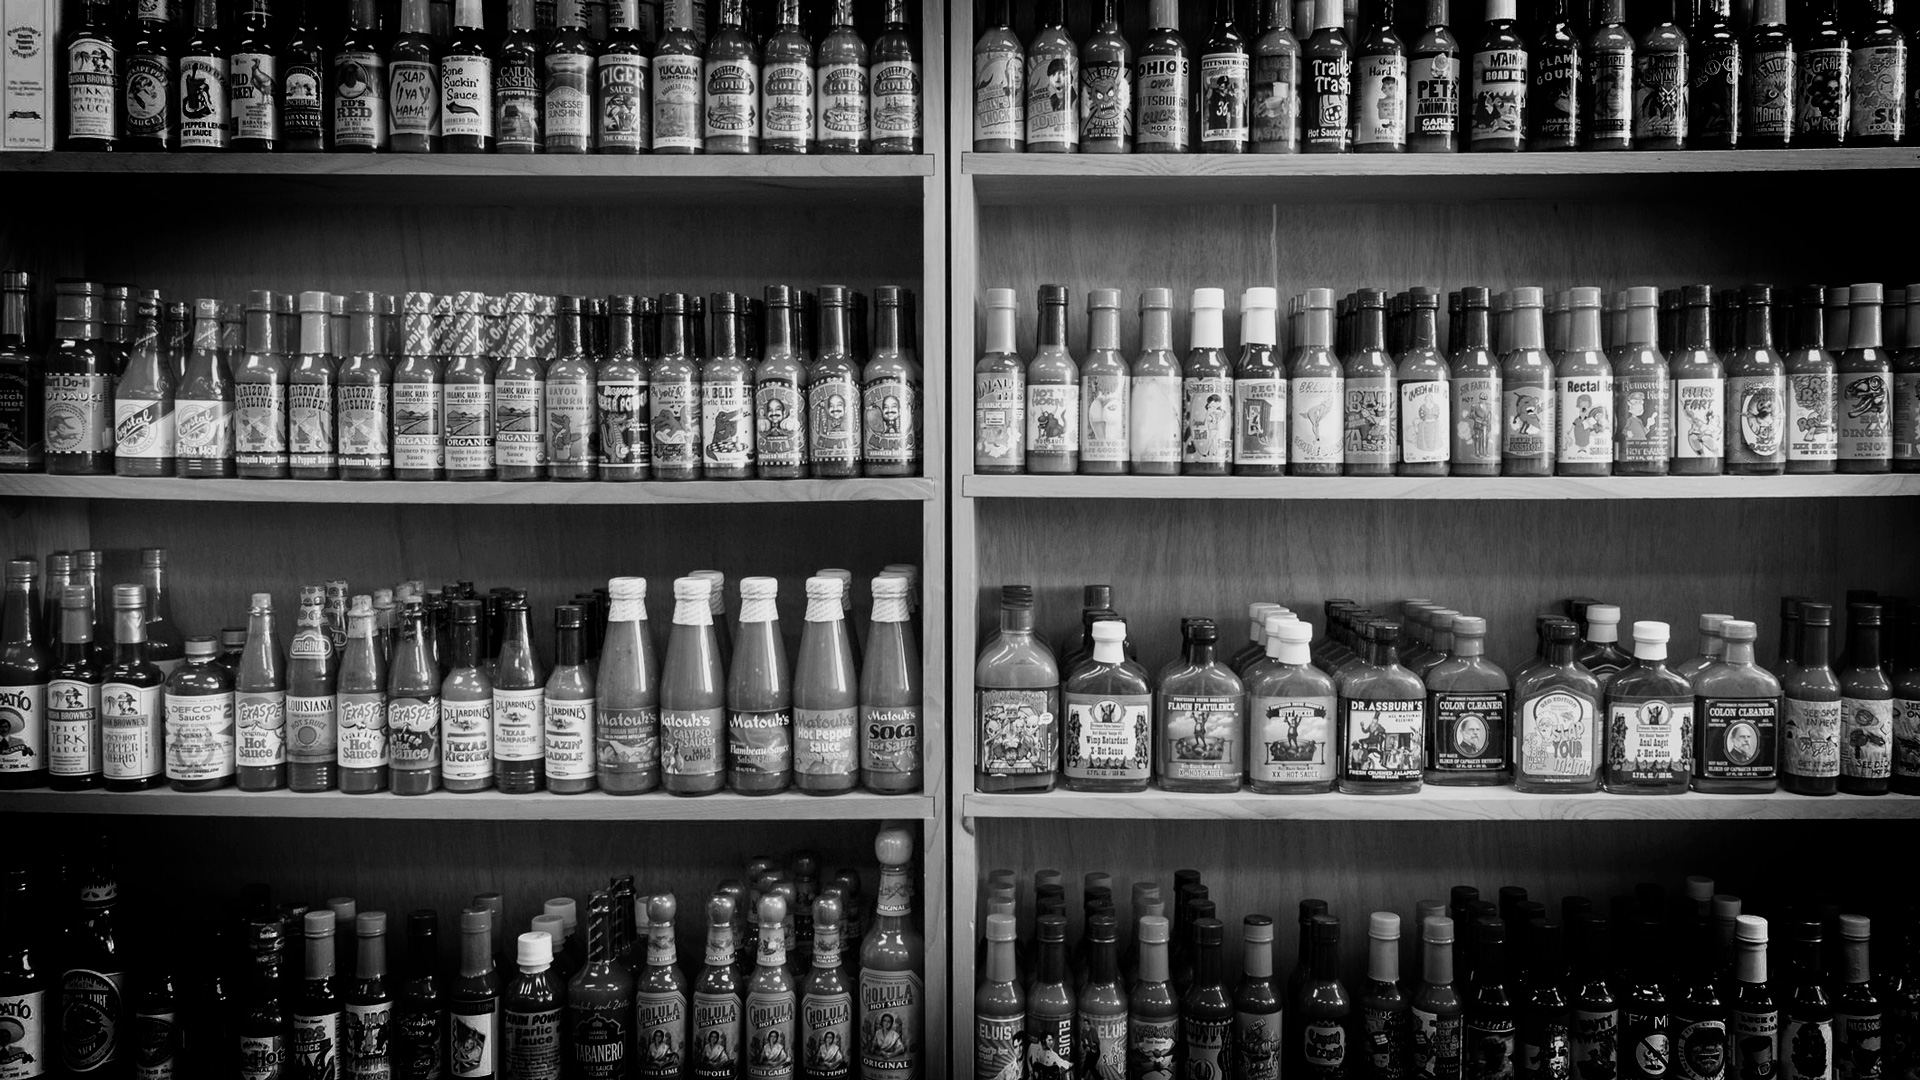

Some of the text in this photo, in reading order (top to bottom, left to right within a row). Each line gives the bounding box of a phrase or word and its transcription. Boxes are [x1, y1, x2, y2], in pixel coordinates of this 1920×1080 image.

[443, 65, 464, 77] Bone
[500, 66, 535, 78] CAJUN
[658, 65, 699, 76] YUCATAN
[1312, 59, 1353, 77] Trailer
[600, 65, 646, 91] TIGER
[1485, 71, 1510, 81] ROAD
[444, 78, 479, 89] Suckin'
[1314, 76, 1351, 95] Trash
[405, 91, 418, 100] YA
[609, 85, 635, 95] SAUCE
[73, 104, 109, 114] SAUCE
[337, 108, 372, 119] RED
[1308, 129, 1319, 137] Hot
[1567, 380, 1600, 392] Rectal
[62, 392, 104, 403] SAUCE
[1032, 388, 1055, 398] HOT
[1347, 391, 1388, 412] BAD
[395, 437, 439, 445] ORGANIC
[447, 439, 491, 447] ORGANIC
[496, 434, 540, 442] ORGANIC
[199, 444, 218, 456] HOT
[287, 699, 333, 712] LOUISIANA
[1194, 702, 1235, 712] FLATULENCE
[1439, 701, 1503, 713] COLON CLEANER
[61, 710, 94, 720] BROWNE'S
[171, 703, 233, 720] DEFCON 2
[237, 702, 267, 722] TEXAS
[341, 702, 370, 722] TEXAS
[867, 710, 915, 721] Matouk's
[1710, 707, 1775, 718] COLON CLEANER
[113, 717, 146, 727] BROWNE'S
[178, 713, 211, 722] Sauces
[597, 710, 657, 727] Matouk's
[730, 713, 789, 729] Matouk's
[50, 733, 85, 746] JERK
[673, 729, 712, 739] CALYPSO
[798, 729, 852, 741] Hot Pepper
[244, 737, 267, 749] Hot
[350, 739, 372, 750] Hot
[447, 740, 487, 751] TEXAS
[684, 738, 712, 747] SAUCE
[50, 746, 86, 754] SAUCE
[239, 746, 274, 758] Sauce
[343, 748, 378, 760] Sauce
[391, 748, 429, 760] Sauce
[1553, 741, 1582, 758] YOUR
[445, 751, 490, 762] KICKER
[862, 982, 913, 1006] CHOLULA
[870, 999, 911, 1010] HOT SAUCE
[638, 1003, 680, 1025] CHOLULA
[695, 1003, 736, 1026] CHOLULA
[749, 1003, 793, 1025] CHOLULA
[806, 1003, 848, 1025] CHOLULA
[515, 1026, 552, 1037] garlic
[515, 1037, 554, 1045] sauce
[575, 1041, 624, 1063] TABANERO
[863, 1059, 909, 1069] ORIGINAL
[694, 1068, 732, 1078] CHIPOTLE
